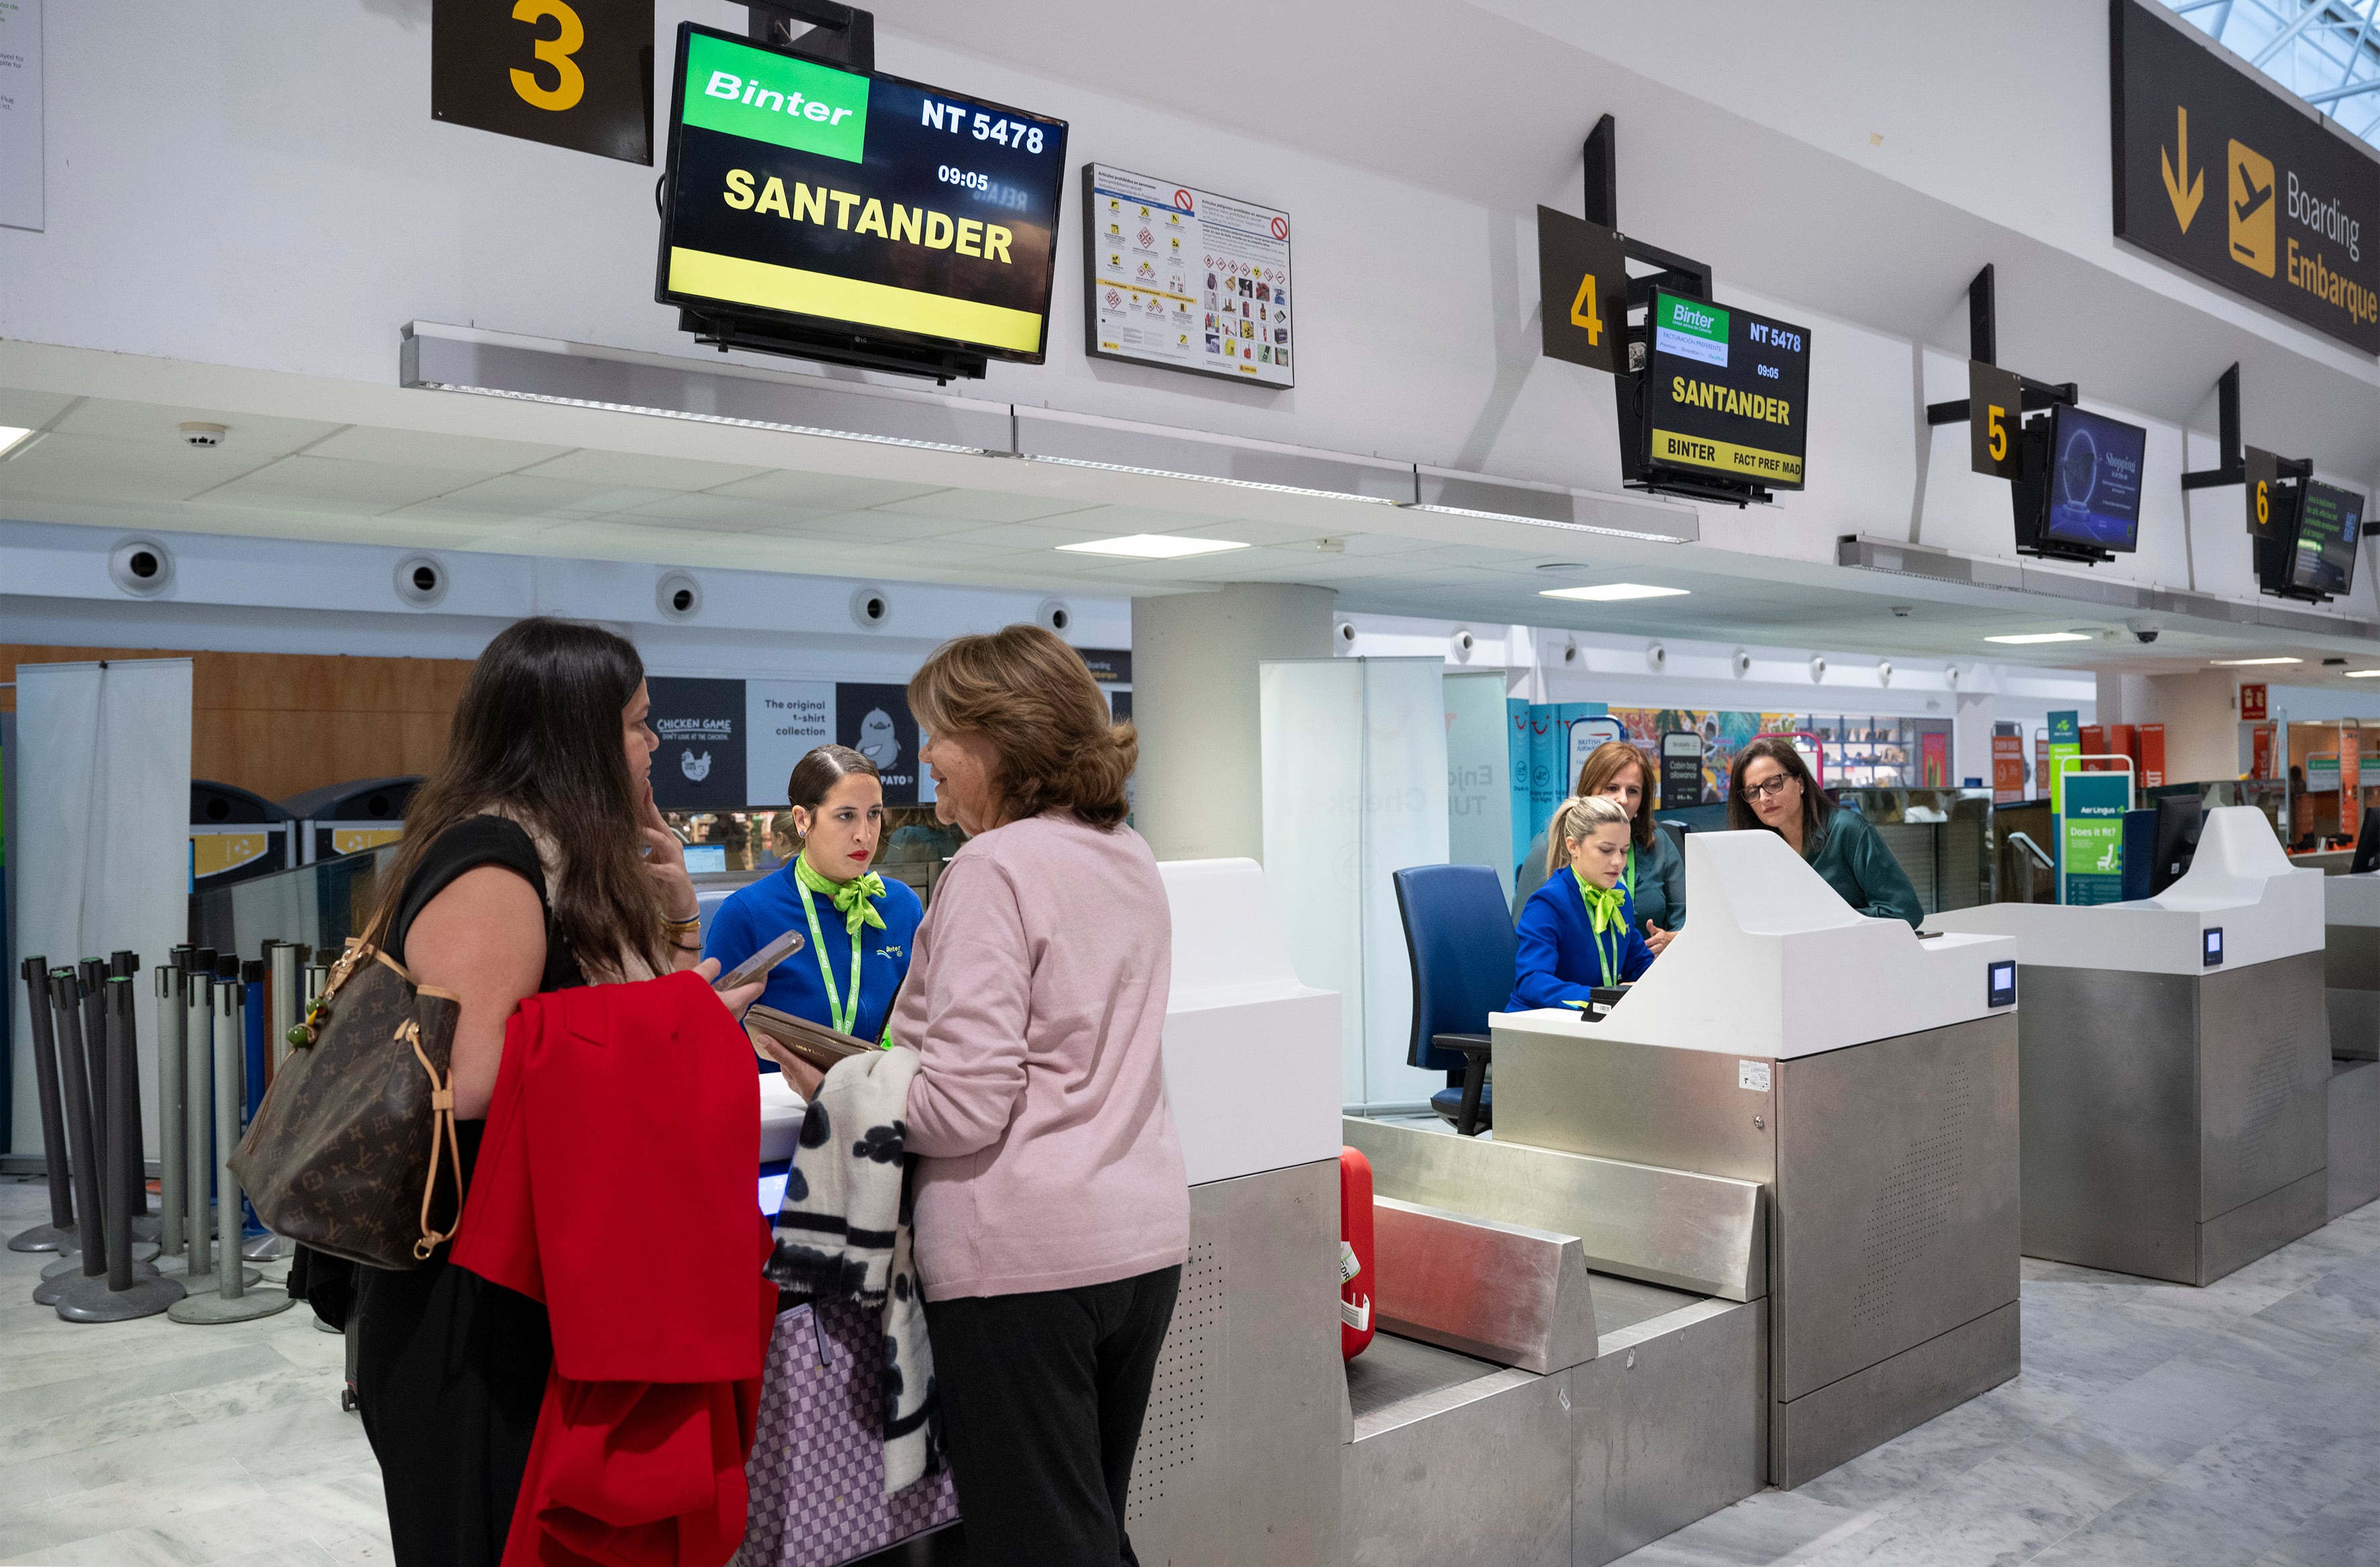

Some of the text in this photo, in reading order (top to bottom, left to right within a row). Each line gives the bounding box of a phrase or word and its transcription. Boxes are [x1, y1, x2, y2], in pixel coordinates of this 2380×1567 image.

[510, 0, 585, 112] 3
[1, 95, 14, 104] Flug
[704, 71, 852, 126] Binter
[921, 99, 1044, 154] NT 5478
[938, 165, 989, 192] 09:05
[723, 169, 1013, 264] SANTANDER
[2288, 171, 2360, 262] Boarding
[2288, 237, 2377, 324] Embarque
[1571, 273, 1603, 347] 4
[1673, 304, 1714, 329] Binter
[1663, 332, 1721, 351] FACTURACIÓN PREFERENTE
[1750, 322, 1801, 353] NT 5478
[1757, 364, 1779, 379] 09:05
[1672, 376, 1790, 426] SANTANDER
[1988, 405, 2007, 462] 5
[1668, 438, 1715, 462] BINTER
[1734, 452, 1801, 475] FACT PREF MAD
[2106, 452, 2135, 474] Shopping
[2256, 480, 2268, 525] 6
[1088, 661, 1110, 671] oarding
[765, 700, 826, 712] The original
[657, 718, 732, 732] CHICKEN GAME
[793, 714, 826, 724] t-shirt
[776, 726, 826, 736] collection
[1670, 761, 1697, 771] Cabin bag
[1670, 771, 1697, 779] allowance
[2093, 806, 2115, 815] Lingus
[2070, 827, 2115, 837] Does it fit?
[809, 913, 819, 933] Binter
[819, 947, 828, 968] Binter
[828, 982, 838, 1004] Binter
